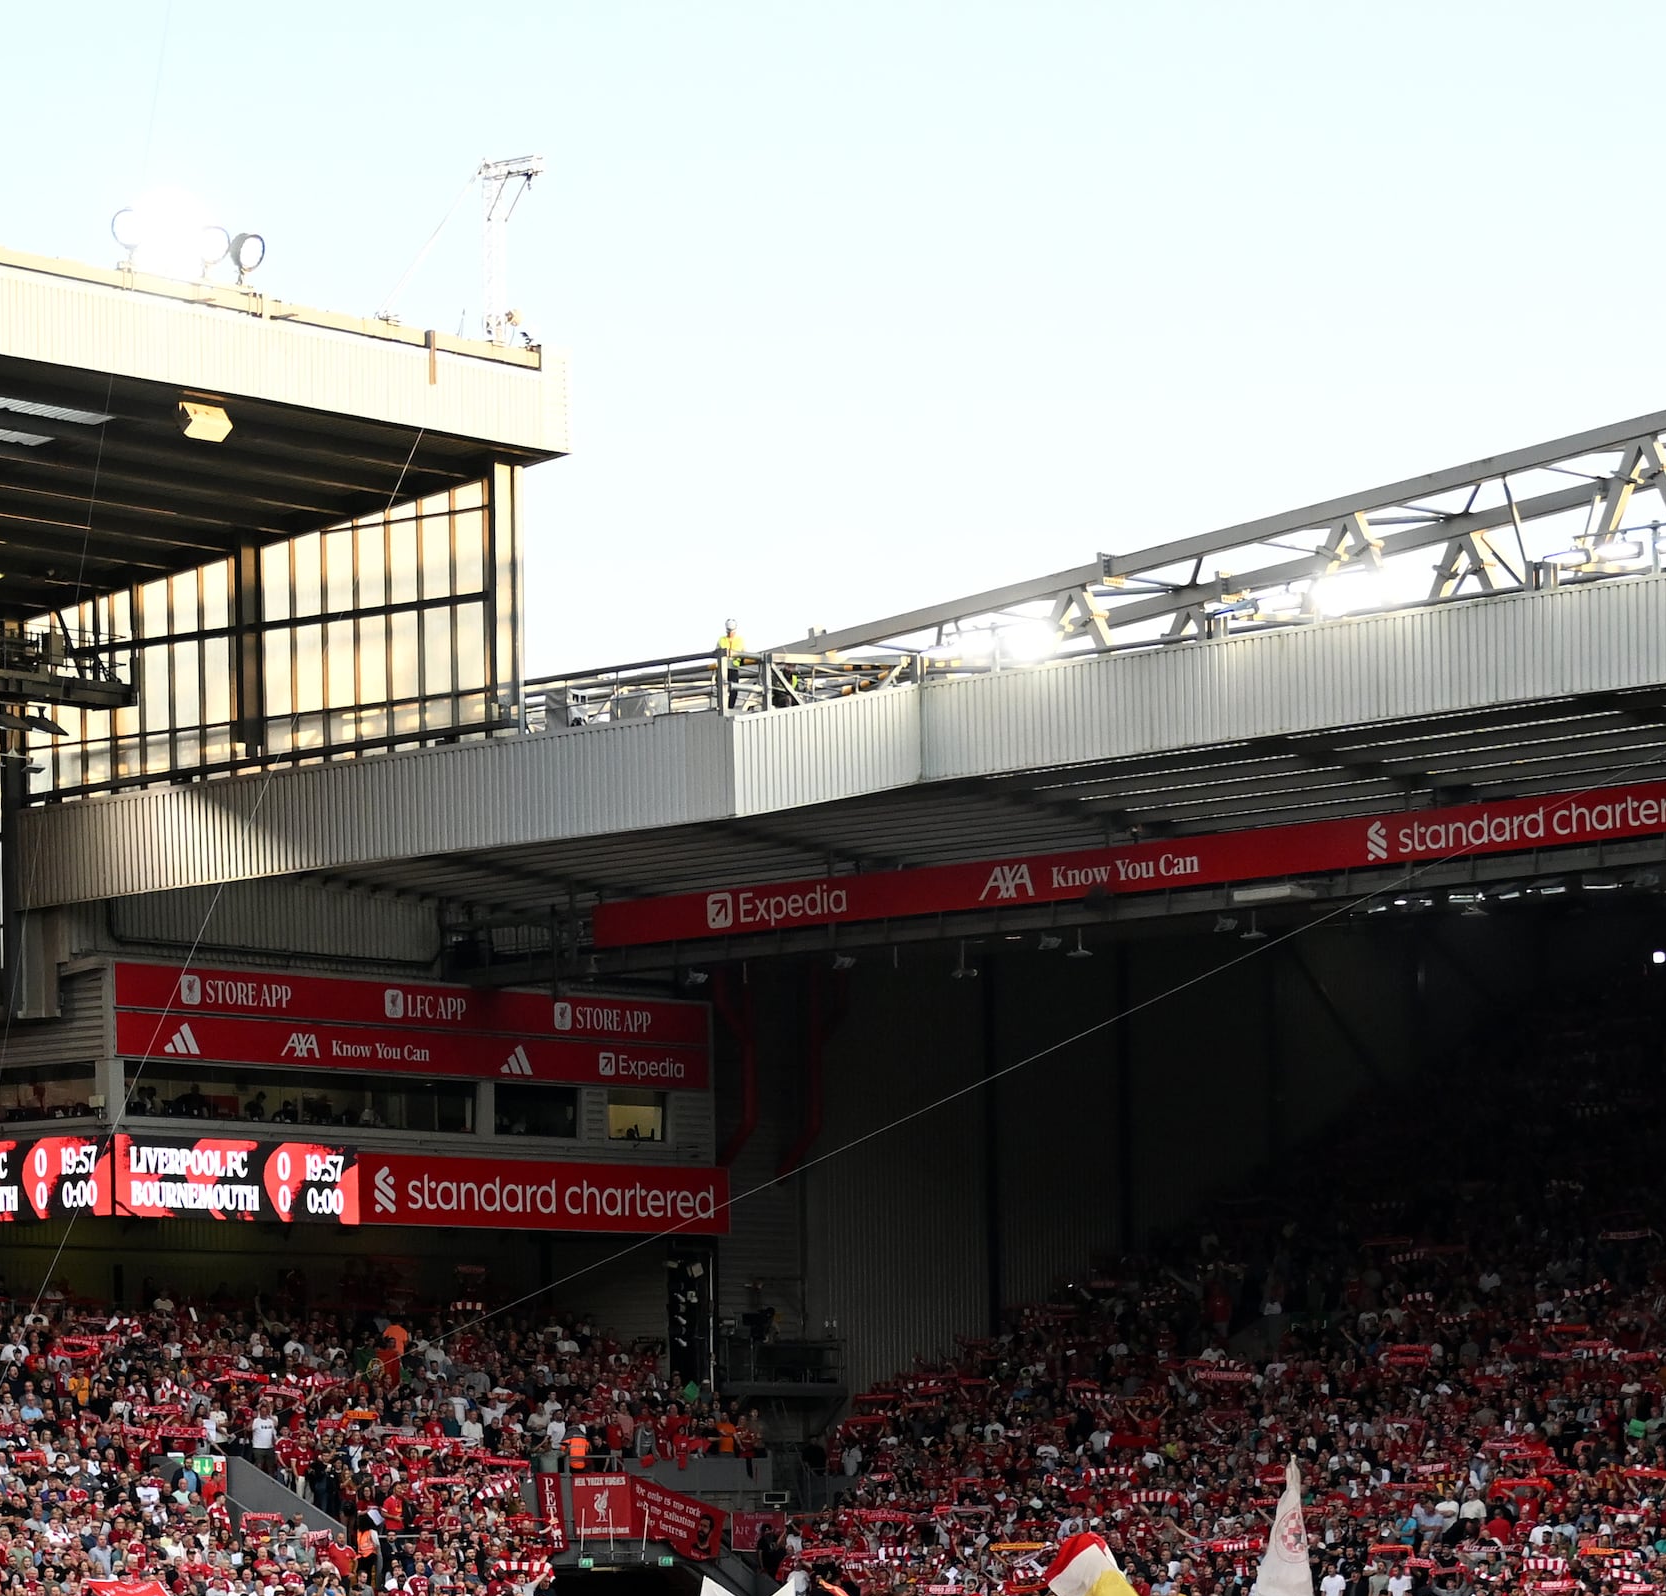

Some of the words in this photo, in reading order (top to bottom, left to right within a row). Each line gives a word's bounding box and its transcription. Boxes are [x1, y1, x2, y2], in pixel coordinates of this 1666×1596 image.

[1398, 806, 1545, 854] standard
[978, 862, 1036, 902] AXA
[1051, 865, 1111, 888] Know
[1115, 859, 1155, 881] You
[1159, 853, 1199, 876] Can
[739, 885, 847, 924] Expedia
[205, 979, 258, 1006] STORE
[259, 983, 292, 1008] APP
[407, 994, 434, 1019] LFC
[436, 997, 467, 1021] APP
[575, 1006, 622, 1032] STORE
[623, 1010, 652, 1033] APP
[280, 1032, 320, 1059] AXA
[332, 1039, 373, 1058] Know
[375, 1042, 401, 1060] You
[403, 1044, 430, 1062] Can
[618, 1054, 685, 1080] Expedia
[33, 1146, 49, 1178] 0
[59, 1142, 101, 1176] 19:57
[129, 1143, 228, 1178] LIVERPOOL
[230, 1149, 250, 1180] FC
[277, 1150, 291, 1182] 0
[304, 1152, 345, 1184] 19:57
[34, 1180, 49, 1212] 0
[61, 1178, 99, 1210] 0:00
[129, 1180, 261, 1214] BOURNEMOUTH
[278, 1182, 292, 1214] 0
[305, 1186, 345, 1215] 0:00
[407, 1173, 557, 1214] standard
[564, 1177, 715, 1219] chartered
[686, 1502, 701, 1518] rock
